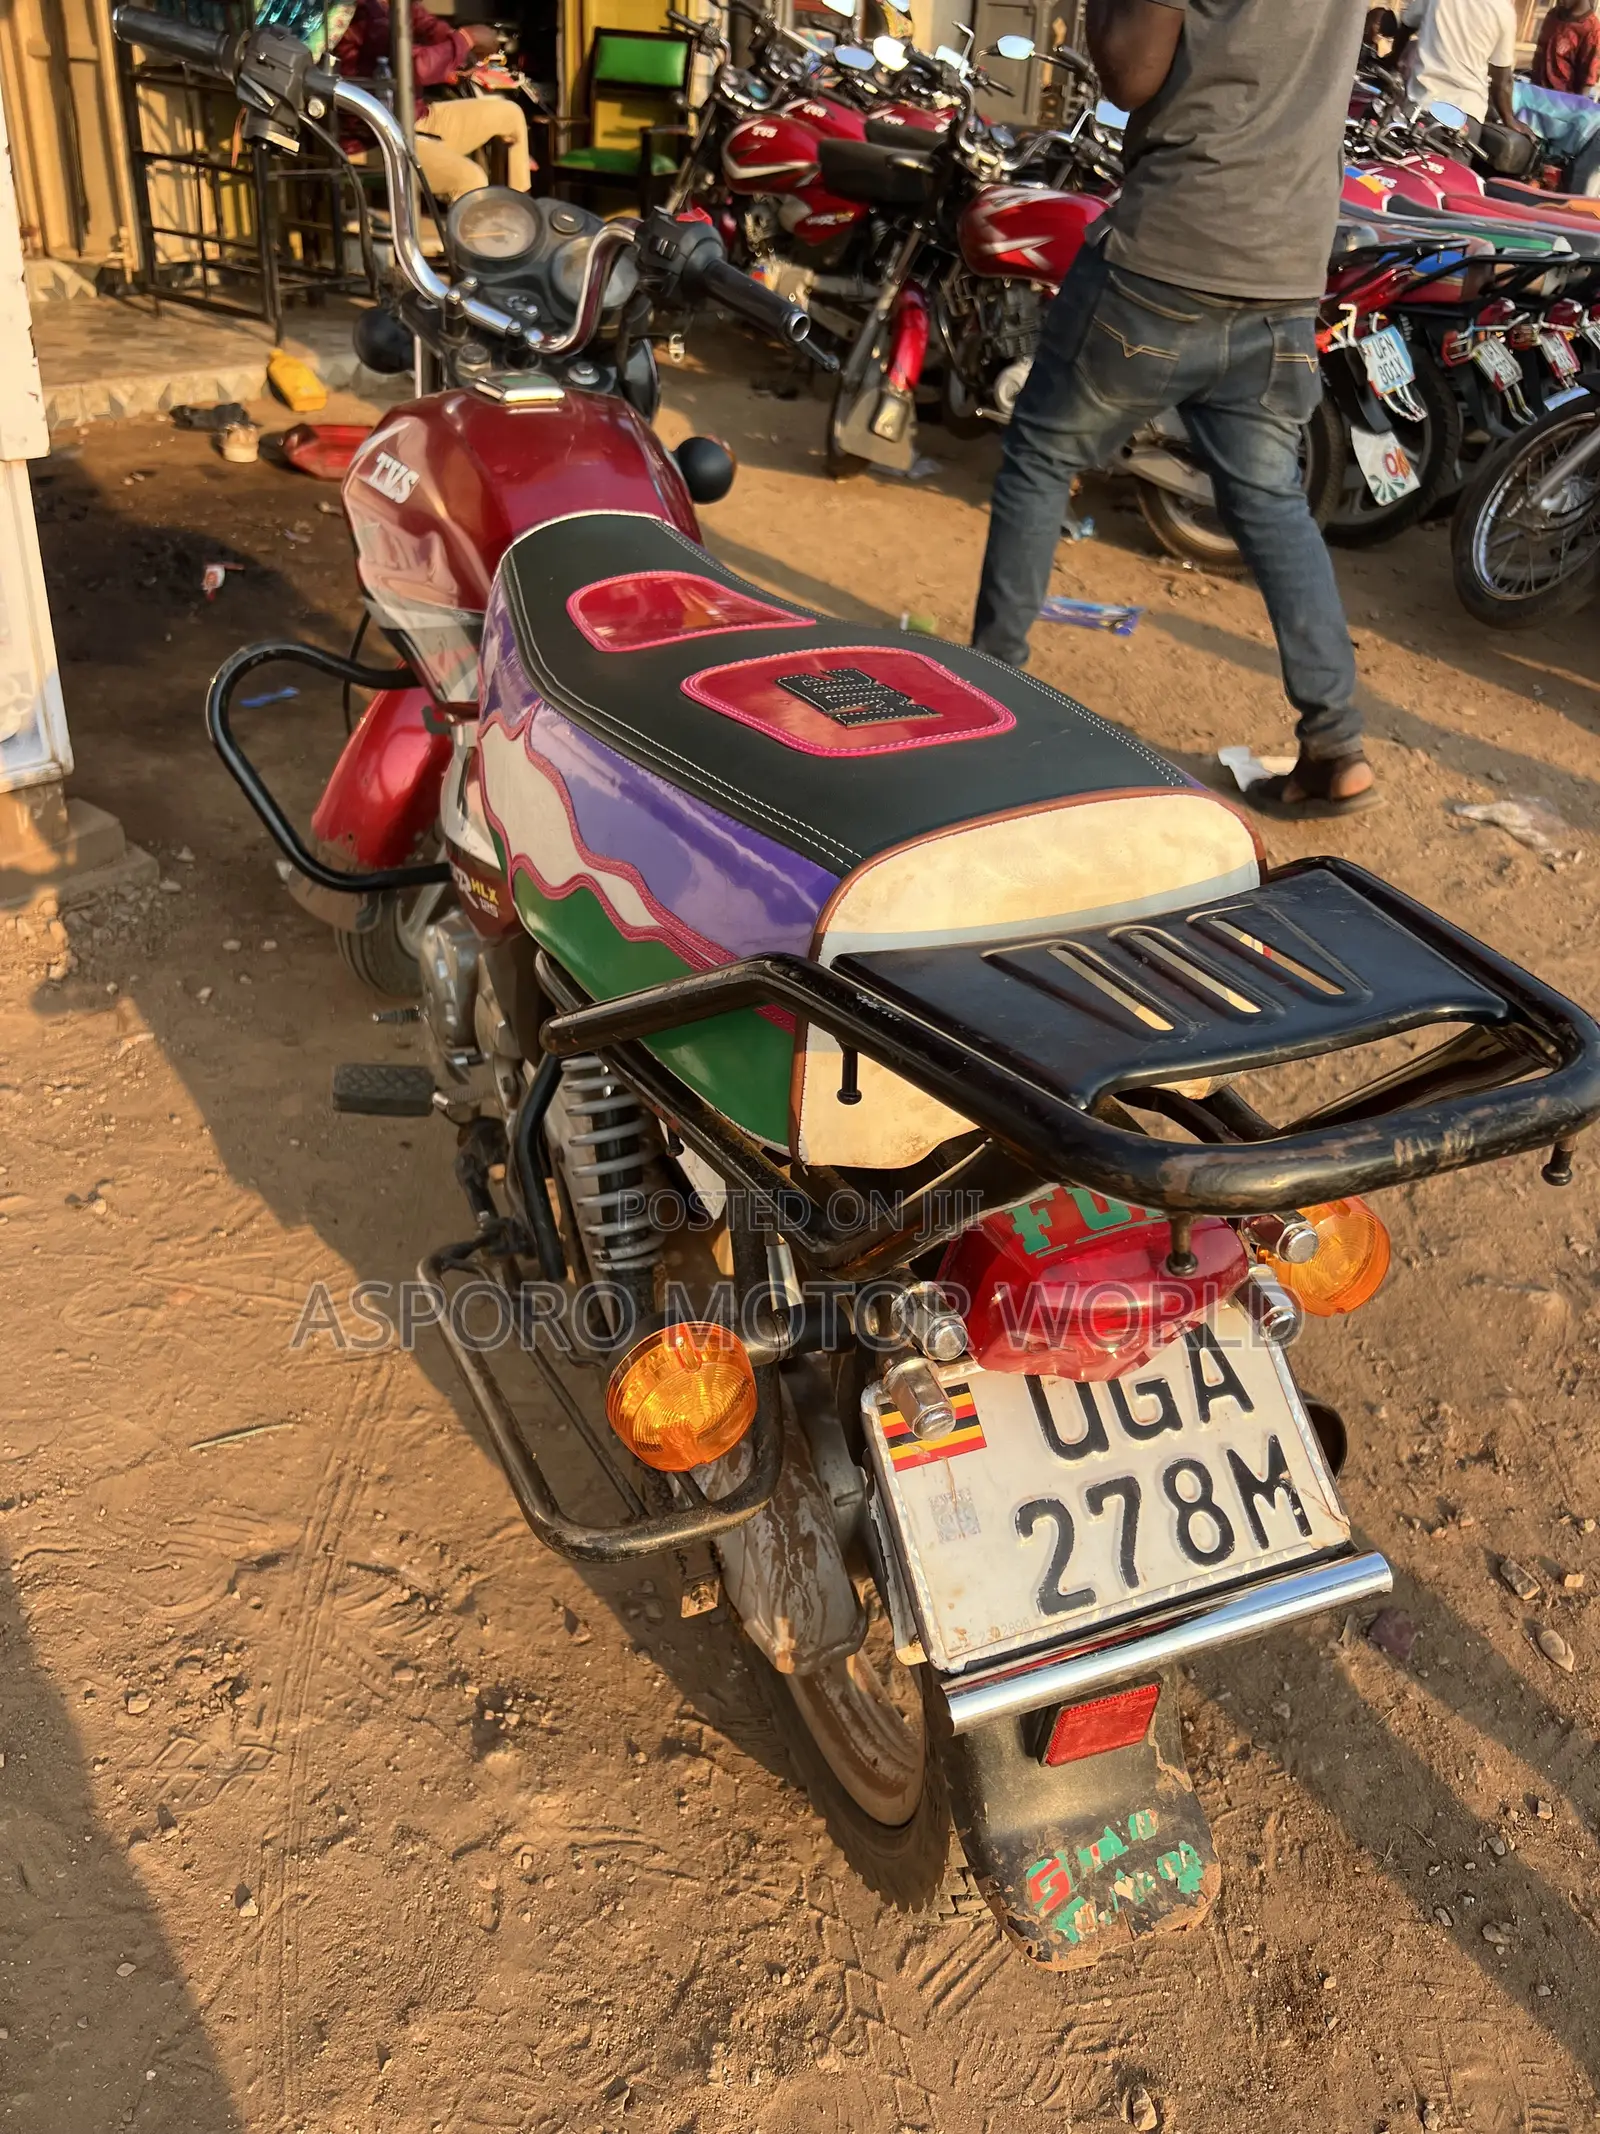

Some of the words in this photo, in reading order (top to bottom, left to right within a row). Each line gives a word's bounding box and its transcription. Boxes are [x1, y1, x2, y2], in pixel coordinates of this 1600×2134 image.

[368, 452, 420, 504] TVS
[471, 877, 499, 906] HLX
[1004, 1186, 1164, 1255] FU
[1024, 1322, 1255, 1461] UGA
[1014, 1434, 1313, 1616] 278M
